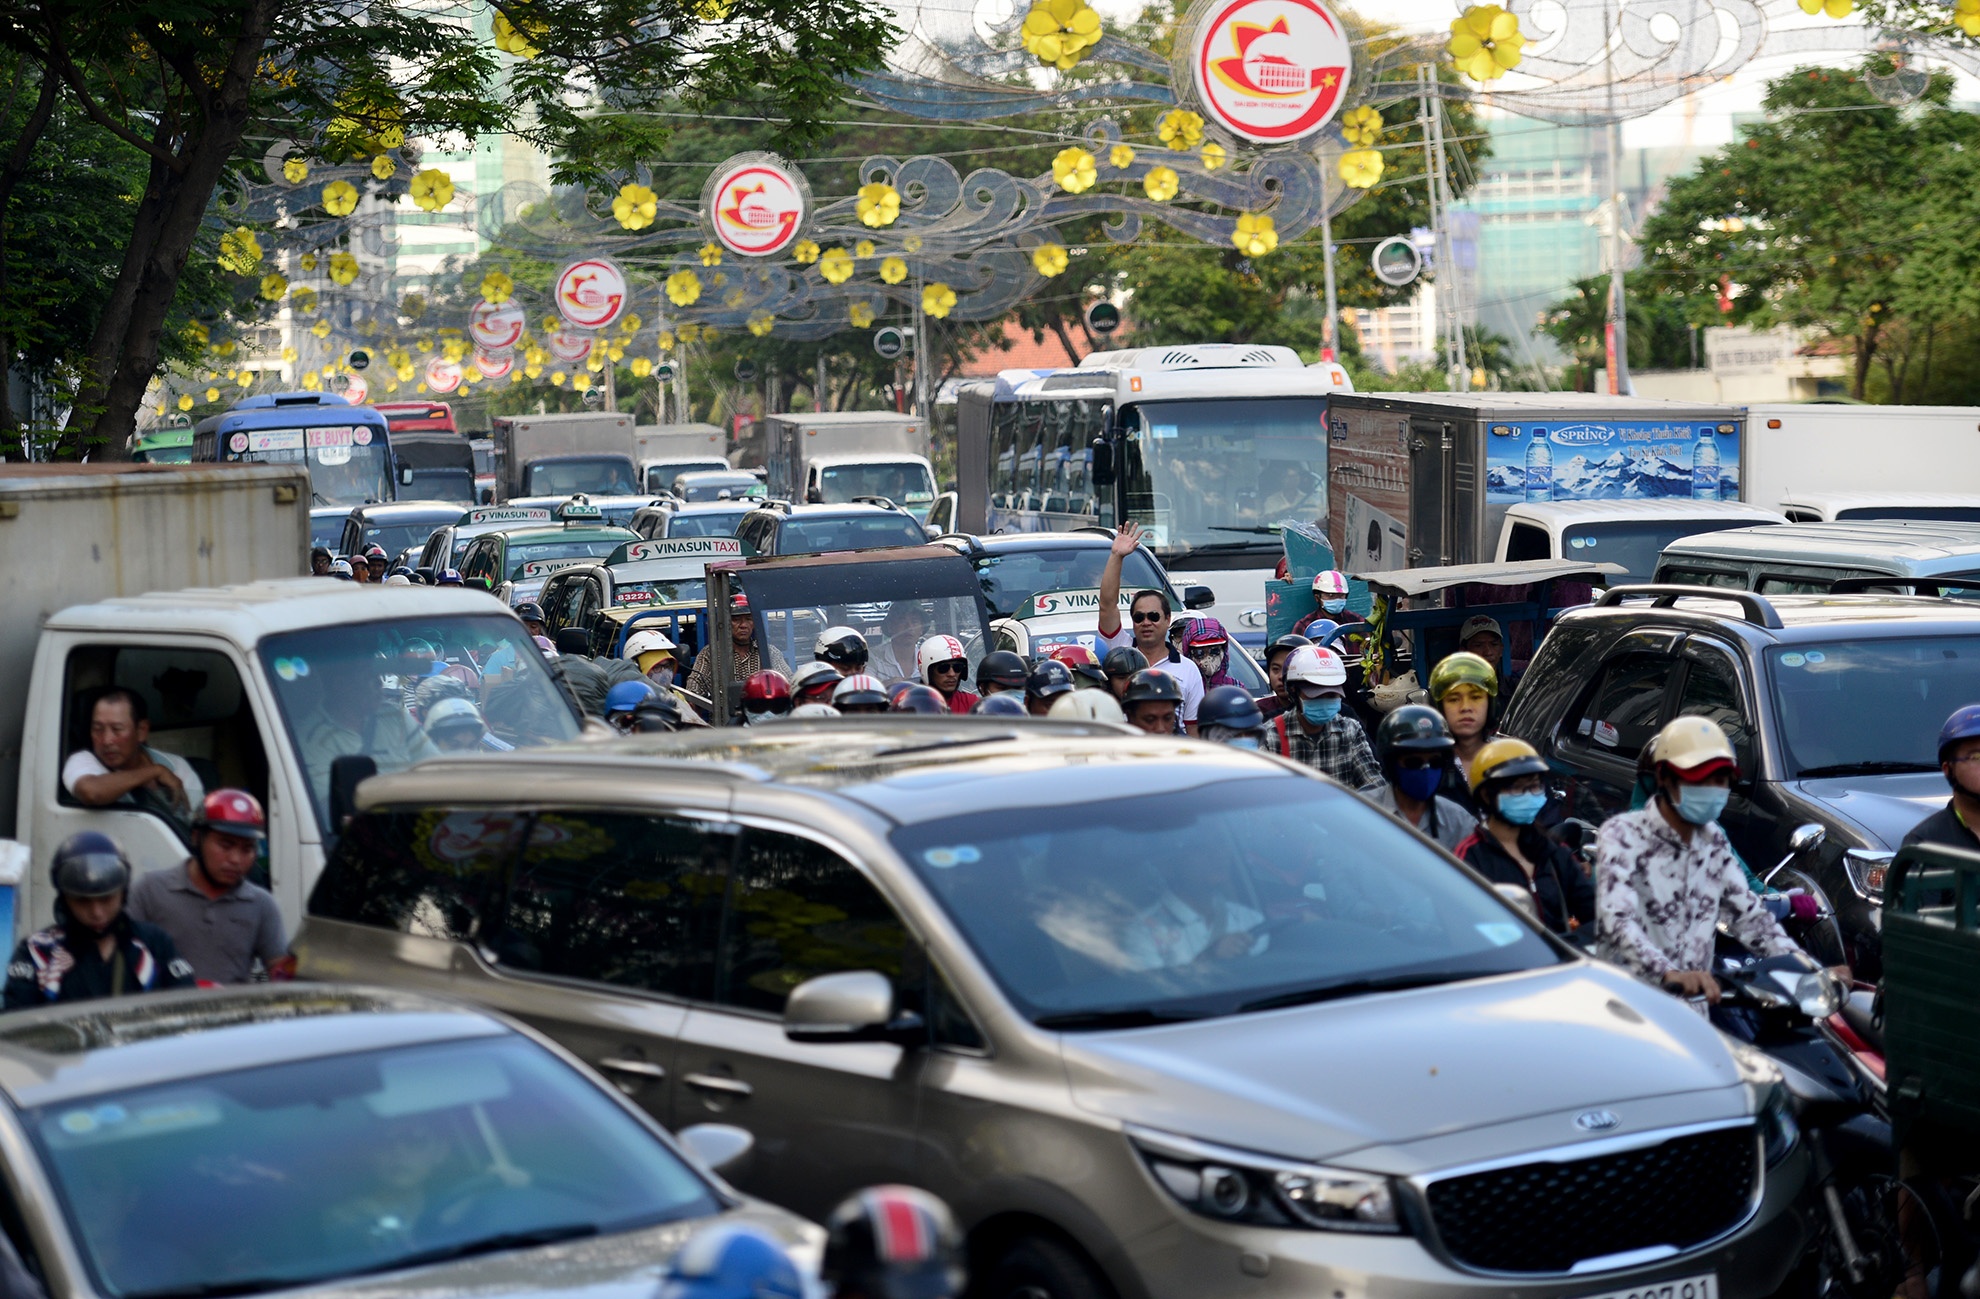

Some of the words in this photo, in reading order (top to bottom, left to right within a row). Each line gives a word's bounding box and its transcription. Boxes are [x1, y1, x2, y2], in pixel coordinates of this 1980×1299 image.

[308, 431, 322, 446] XE
[357, 430, 368, 441] 12
[1560, 427, 1607, 440] SPRING
[232, 436, 245, 448] 12
[1337, 461, 1406, 493] AUSTRALIA
[489, 510, 528, 519] VINASUN
[568, 506, 597, 515] TAXI
[654, 541, 712, 555] VINASUN
[713, 541, 739, 553] TAXI
[1065, 593, 1130, 607] VINAN
